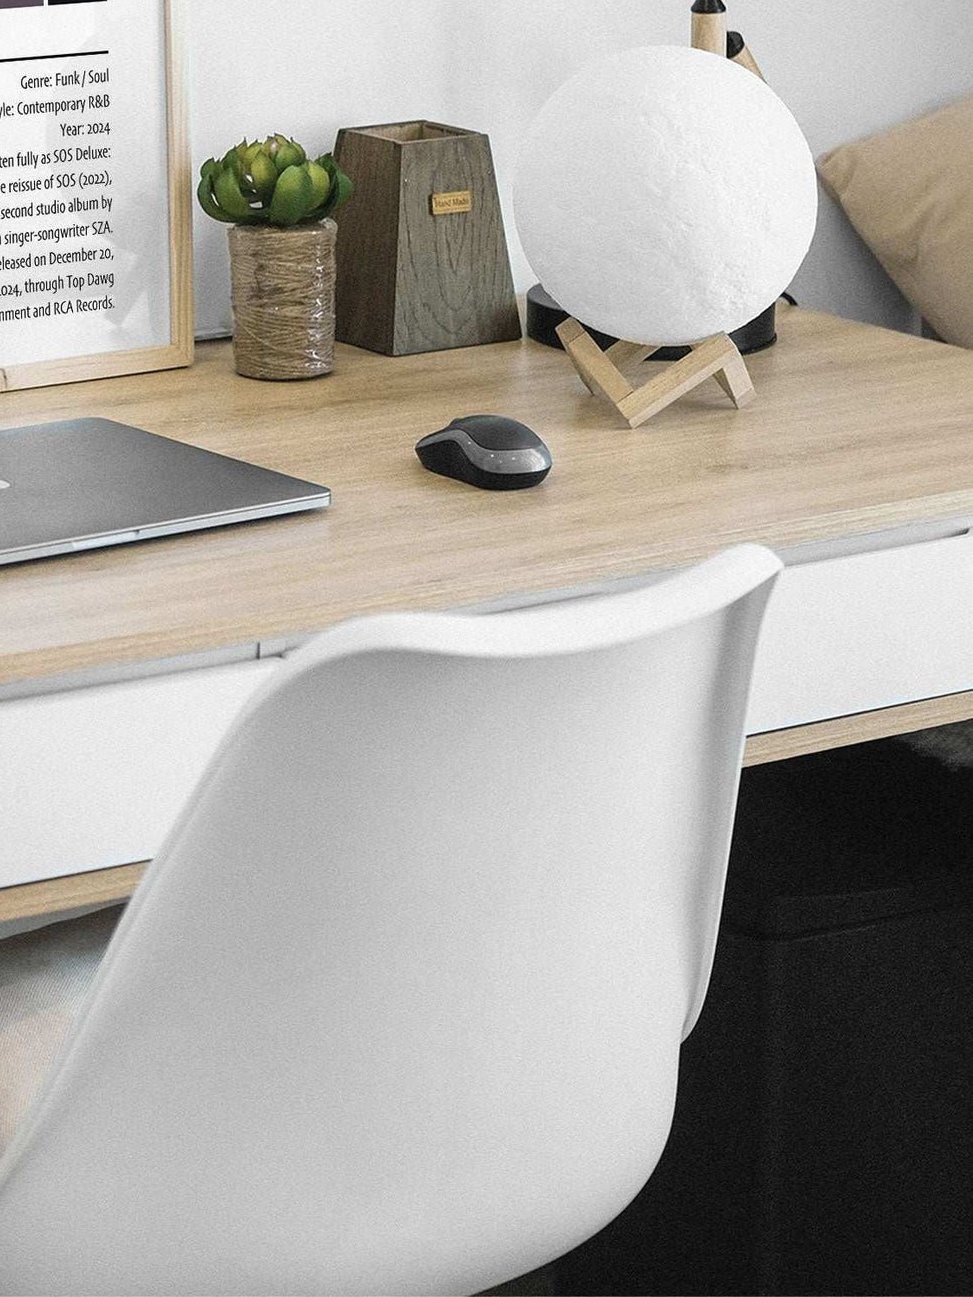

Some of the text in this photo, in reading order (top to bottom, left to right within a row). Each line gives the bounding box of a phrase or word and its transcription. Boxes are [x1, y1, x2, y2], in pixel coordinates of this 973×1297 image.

[20, 75, 53, 90] Genre:
[55, 70, 81, 87] Funk
[88, 68, 109, 84] Soul
[17, 99, 86, 116] Contemporary
[88, 94, 110, 109] R&B
[59, 122, 111, 137] Year: 2024
[16, 151, 39, 169] fully
[40, 153, 51, 165] as
[53, 147, 73, 164] SOS
[75, 145, 111, 161] Deluxe:
[8, 178, 42, 193] reissue
[43, 174, 54, 190] of
[56, 173, 76, 189] SOS
[78, 170, 113, 190] (2022),
[0, 202, 34, 220] second
[36, 199, 66, 216] studio
[68, 197, 99, 213] album
[101, 195, 113, 213] by
[4, 223, 90, 248] singer-songwriter
[91, 220, 114, 236] SZA.
[33, 255, 47, 267] on
[49, 247, 98, 265] December
[99, 248, 114, 261] 20,
[24, 275, 64, 295] through
[66, 274, 85, 291] Top
[87, 272, 115, 288] Dawg
[32, 301, 51, 318] and
[53, 300, 74, 315] RCA
[76, 294, 115, 313] Records.
